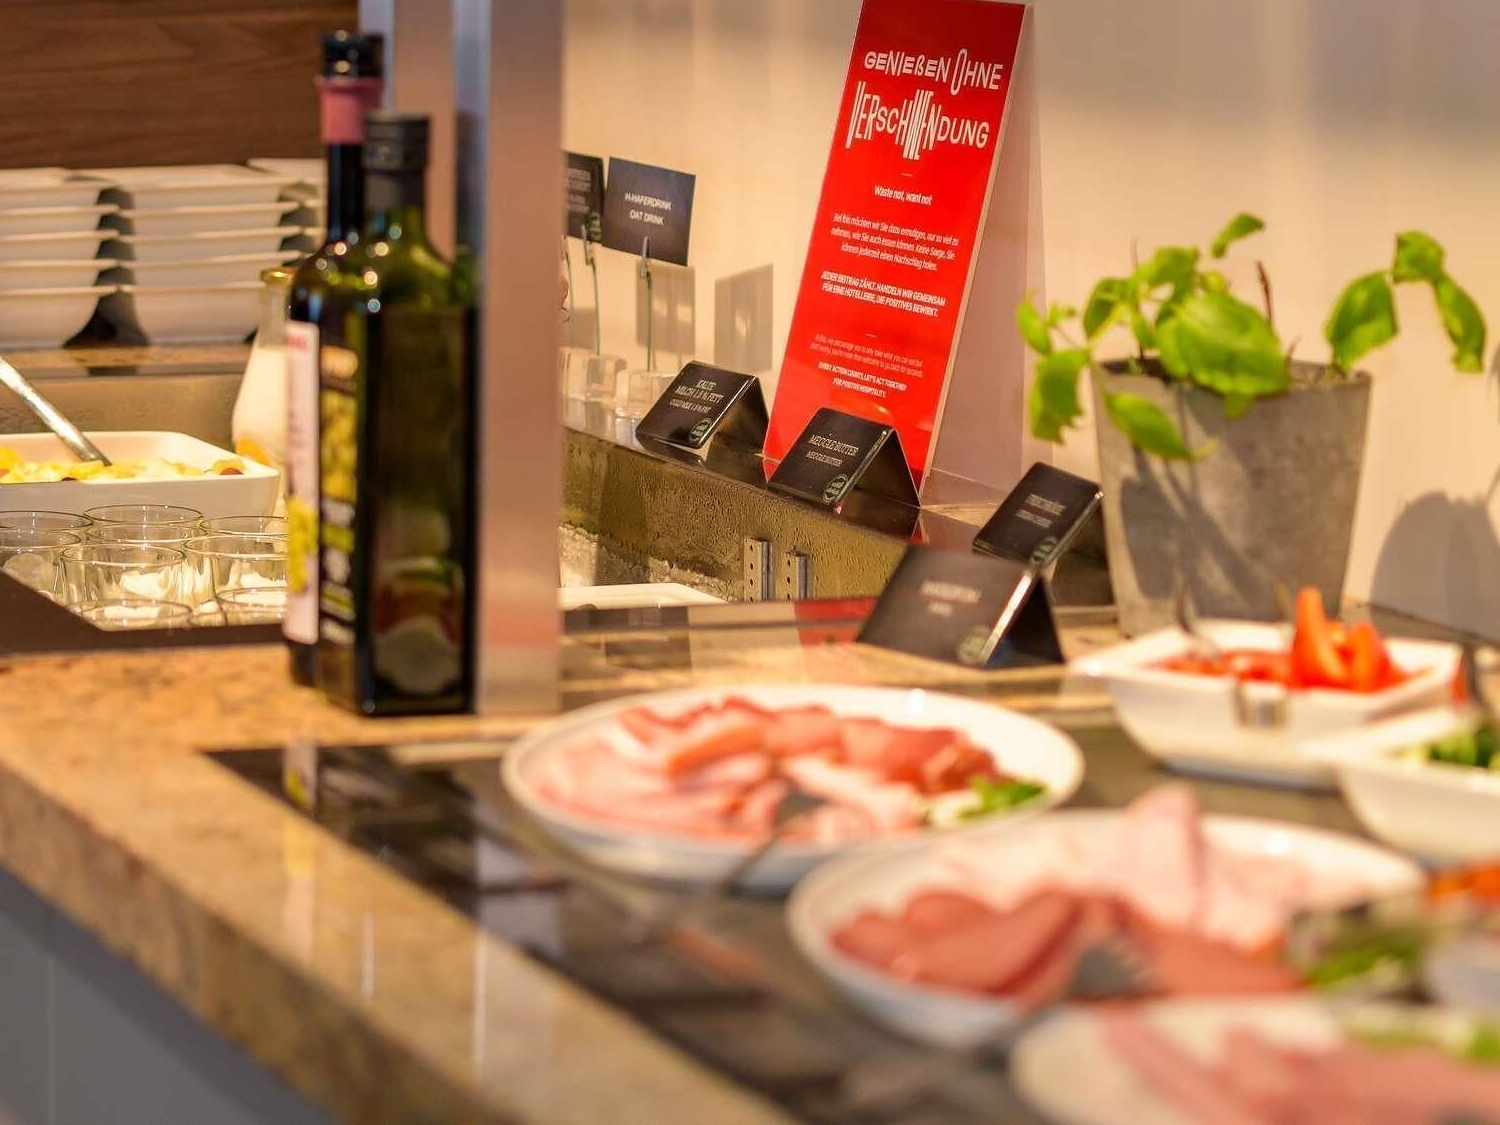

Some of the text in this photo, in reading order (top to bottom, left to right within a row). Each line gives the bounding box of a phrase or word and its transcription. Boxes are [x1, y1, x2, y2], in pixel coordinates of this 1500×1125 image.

[950, 48, 1004, 96] OHNE
[845, 80, 990, 160] VERSCHWENDUNG
[874, 184, 932, 206] Waste not, want not
[629, 210, 665, 225] OAT DRINK
[837, 274, 860, 287] BEITRAG
[877, 282, 903, 296] HANDELN
[901, 288, 914, 299] WIR
[912, 291, 946, 307] GEMEINSAM
[885, 297, 914, 312] POSITIVES
